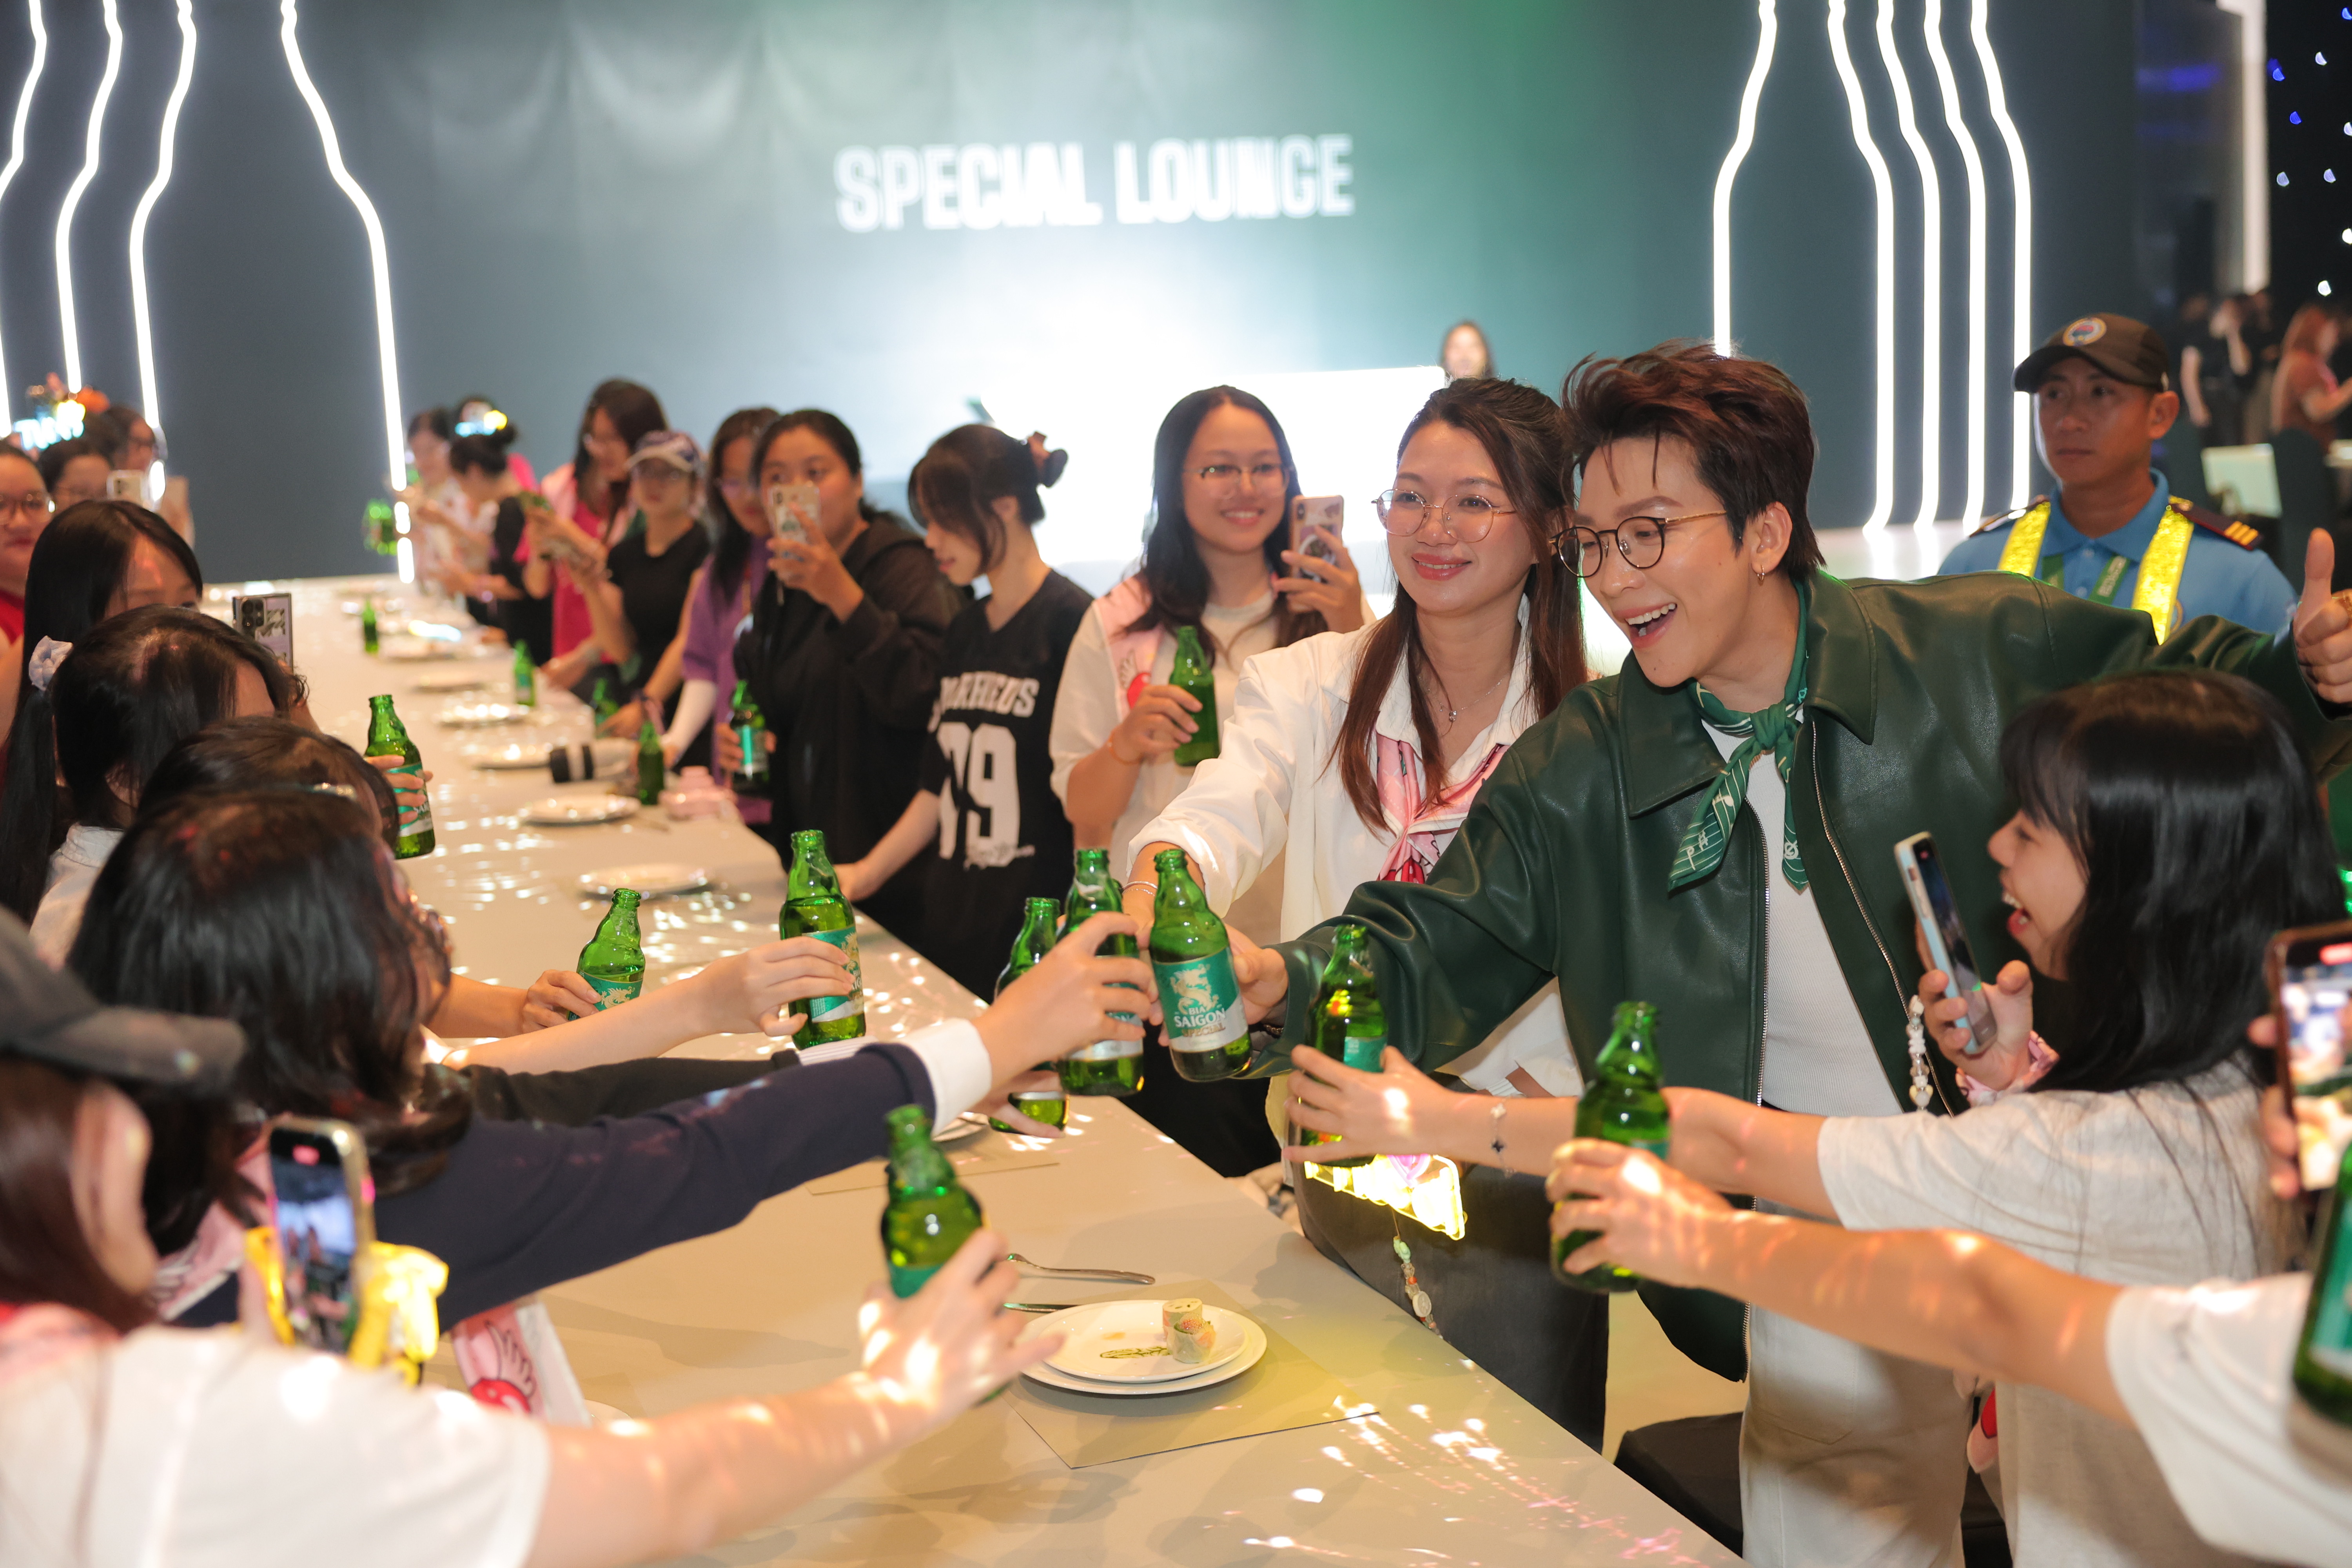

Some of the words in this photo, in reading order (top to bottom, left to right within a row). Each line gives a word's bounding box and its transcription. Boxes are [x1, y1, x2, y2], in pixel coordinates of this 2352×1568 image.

[834, 142, 1102, 233] SPECIAL
[1113, 134, 1355, 224] LOUNGE
[1174, 1007, 1226, 1028] SAIGON
[1189, 1005, 1206, 1015] BIA
[1182, 1022, 1226, 1037] SPECIAL
